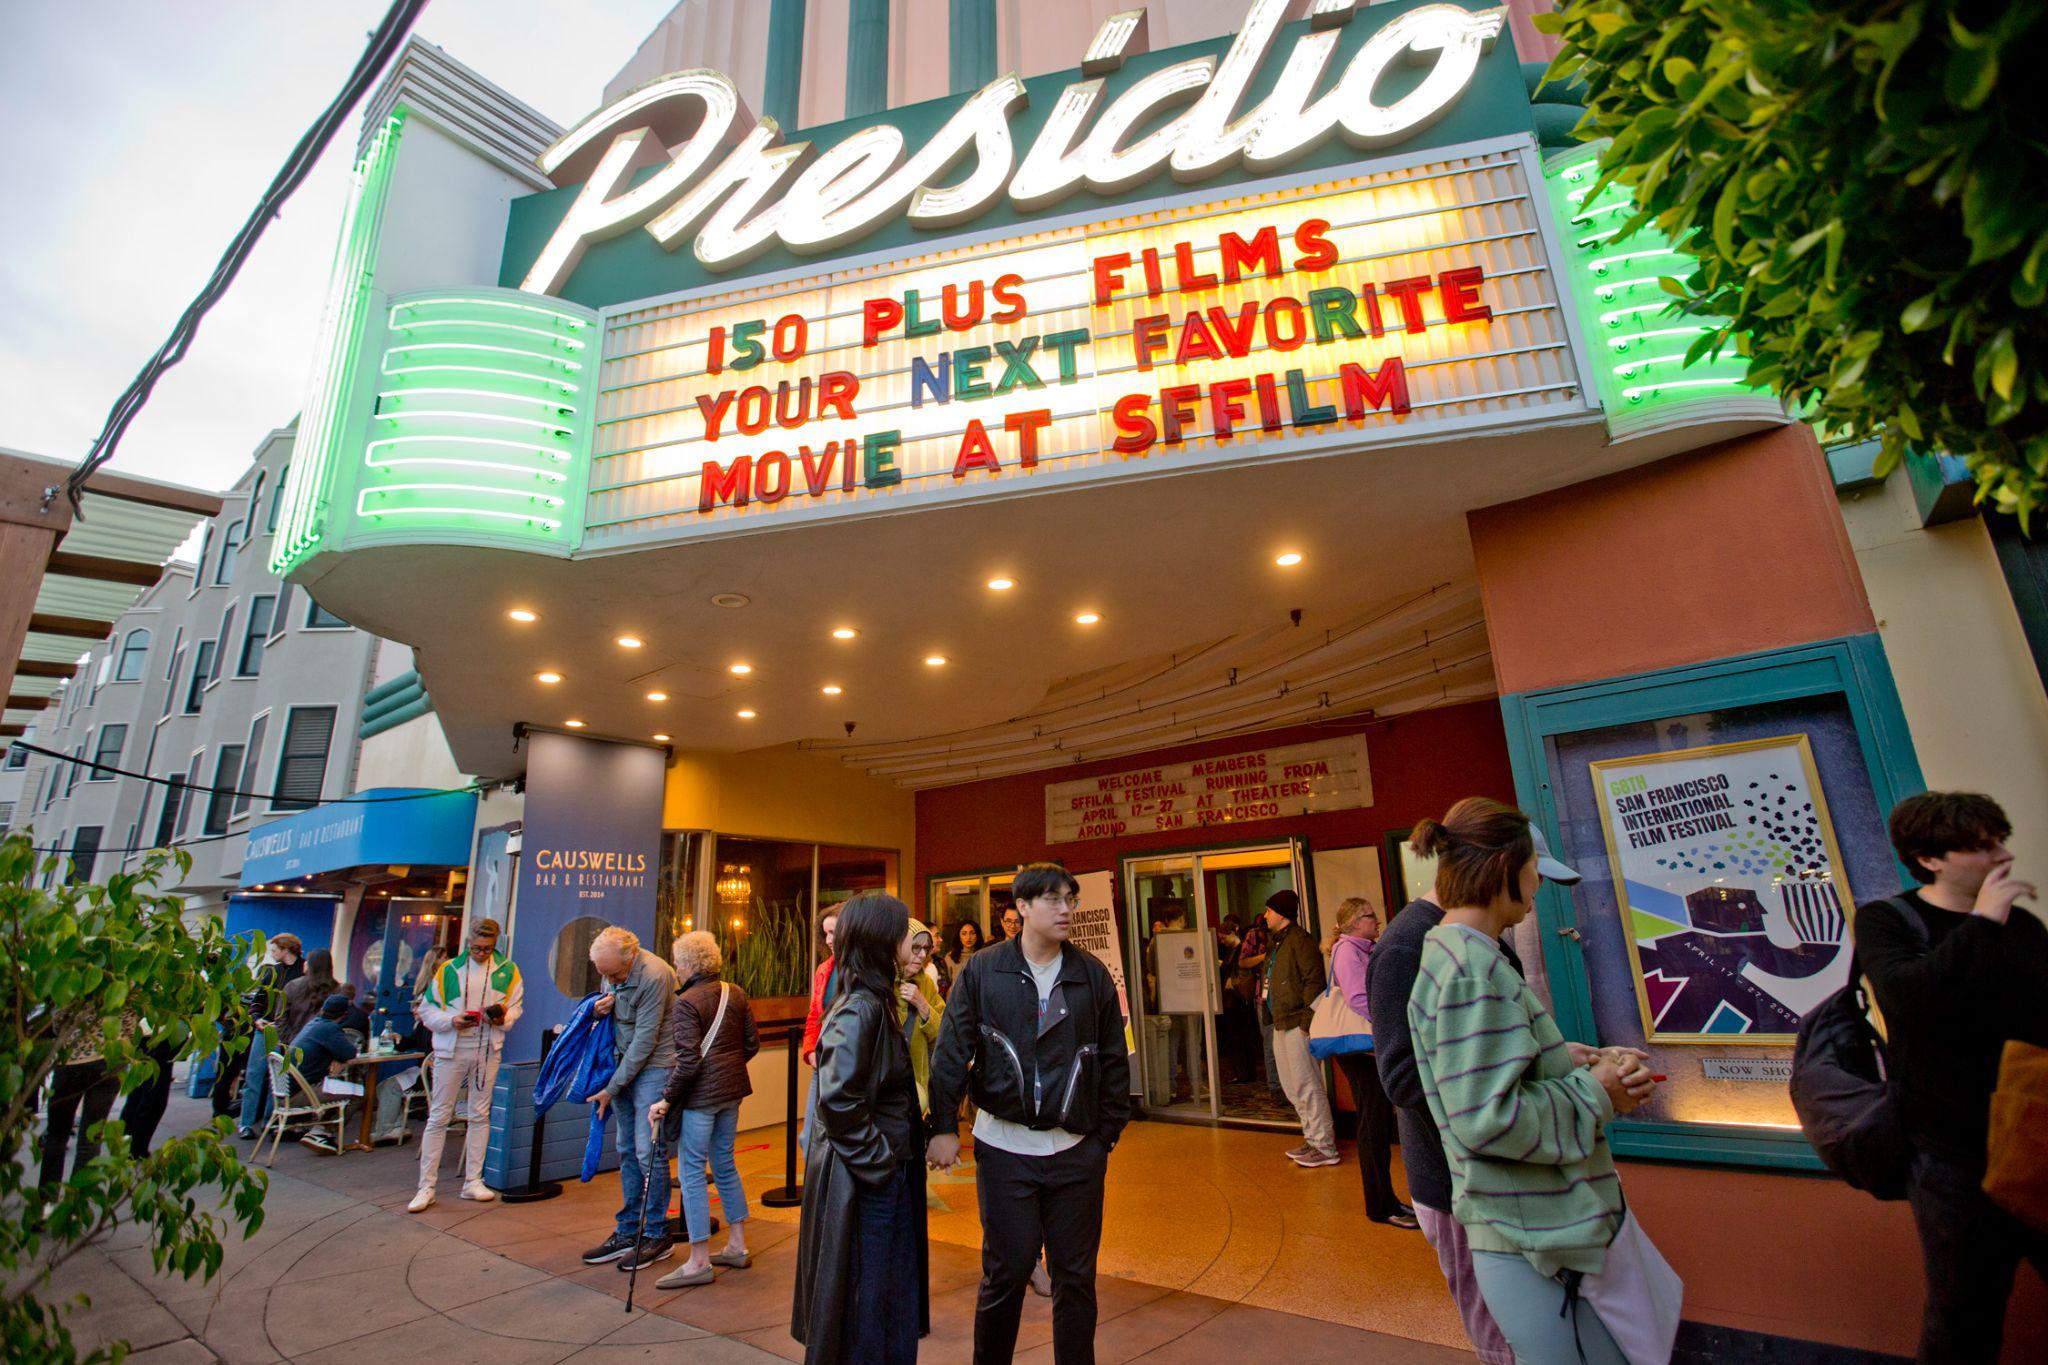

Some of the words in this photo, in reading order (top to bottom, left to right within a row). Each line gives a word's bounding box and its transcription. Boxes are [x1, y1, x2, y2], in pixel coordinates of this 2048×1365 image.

[519, 0, 1508, 296] Presidio
[863, 273, 1028, 348] PLUS
[1094, 219, 1339, 307] FILMS
[695, 370, 860, 442] YOUR
[911, 327, 1090, 409] NEXT
[1134, 266, 1494, 372] FAVORITE
[698, 429, 903, 513] MOVIE
[952, 408, 1052, 479] AT
[1112, 356, 1412, 454] SFFILM
[1071, 793, 1114, 810] SFFILM
[1124, 783, 1187, 802] FESTIVAL
[1206, 770, 1268, 790] RUNNING
[1283, 761, 1328, 779] FROM
[1097, 770, 1163, 791] WELCOME
[1192, 753, 1267, 777] MEMBERS
[1610, 774, 1647, 796] 68TH
[1083, 807, 1118, 823] APRIL
[1197, 794, 1214, 808] AT
[1232, 781, 1310, 803] THEATERS
[1616, 793, 1646, 814] SAN
[1647, 773, 1730, 806] FRANCISCO
[1622, 792, 1735, 832] INTERNATIONAL
[1078, 821, 1126, 839] AROUND
[1156, 814, 1183, 830] SAN
[1197, 803, 1279, 823] FRANCISCO
[1628, 827, 1667, 849] FILM
[1667, 812, 1737, 840] FESTIVAL
[536, 849, 646, 872] CAUSWELLS
[536, 873, 557, 886] BAR
[578, 874, 645, 888] RESTAURANT
[1068, 922, 1110, 939] NATIONAL
[1072, 908, 1110, 925] RANCISCO
[1684, 941, 1715, 966] APRIL
[1721, 967, 1733, 977] 17
[1769, 1002, 1798, 1024] 2025
[1719, 1065, 1753, 1075] NOW
[1761, 1066, 1793, 1077] SHO
